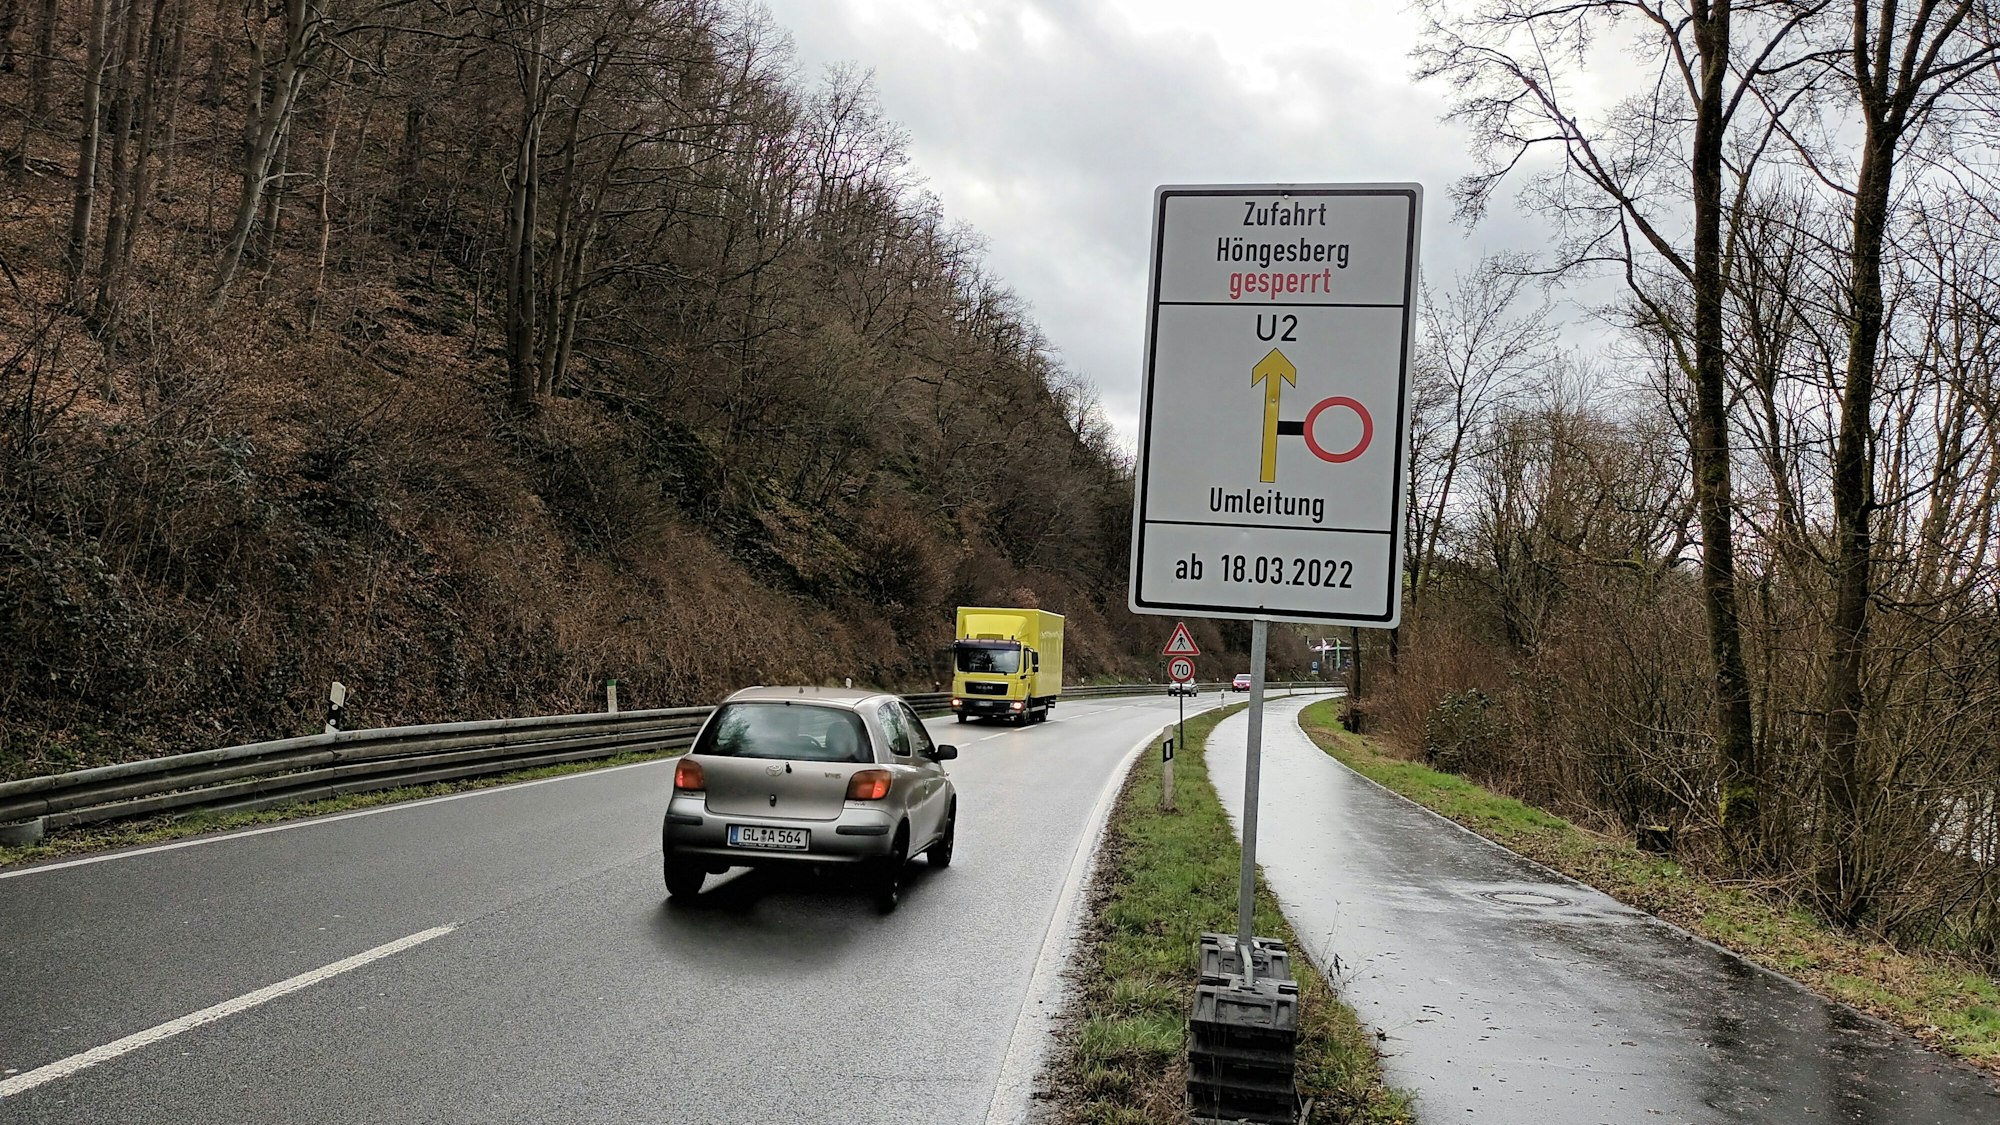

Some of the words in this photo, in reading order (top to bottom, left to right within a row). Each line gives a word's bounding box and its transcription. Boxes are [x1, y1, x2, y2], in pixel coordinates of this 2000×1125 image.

[1243, 201, 1327, 227] Zufahrt
[1216, 237, 1350, 269] Höngesberg
[1229, 267, 1332, 300] gesperrt
[1256, 314, 1298, 342] U2
[1209, 487, 1325, 523] Umleitung
[1175, 552, 1203, 581] ab
[1220, 554, 1354, 589] 18.03.2022
[1174, 663, 1189, 676] 70
[743, 828, 759, 842] GL
[767, 830, 775, 843] A
[778, 830, 801, 844] 564
